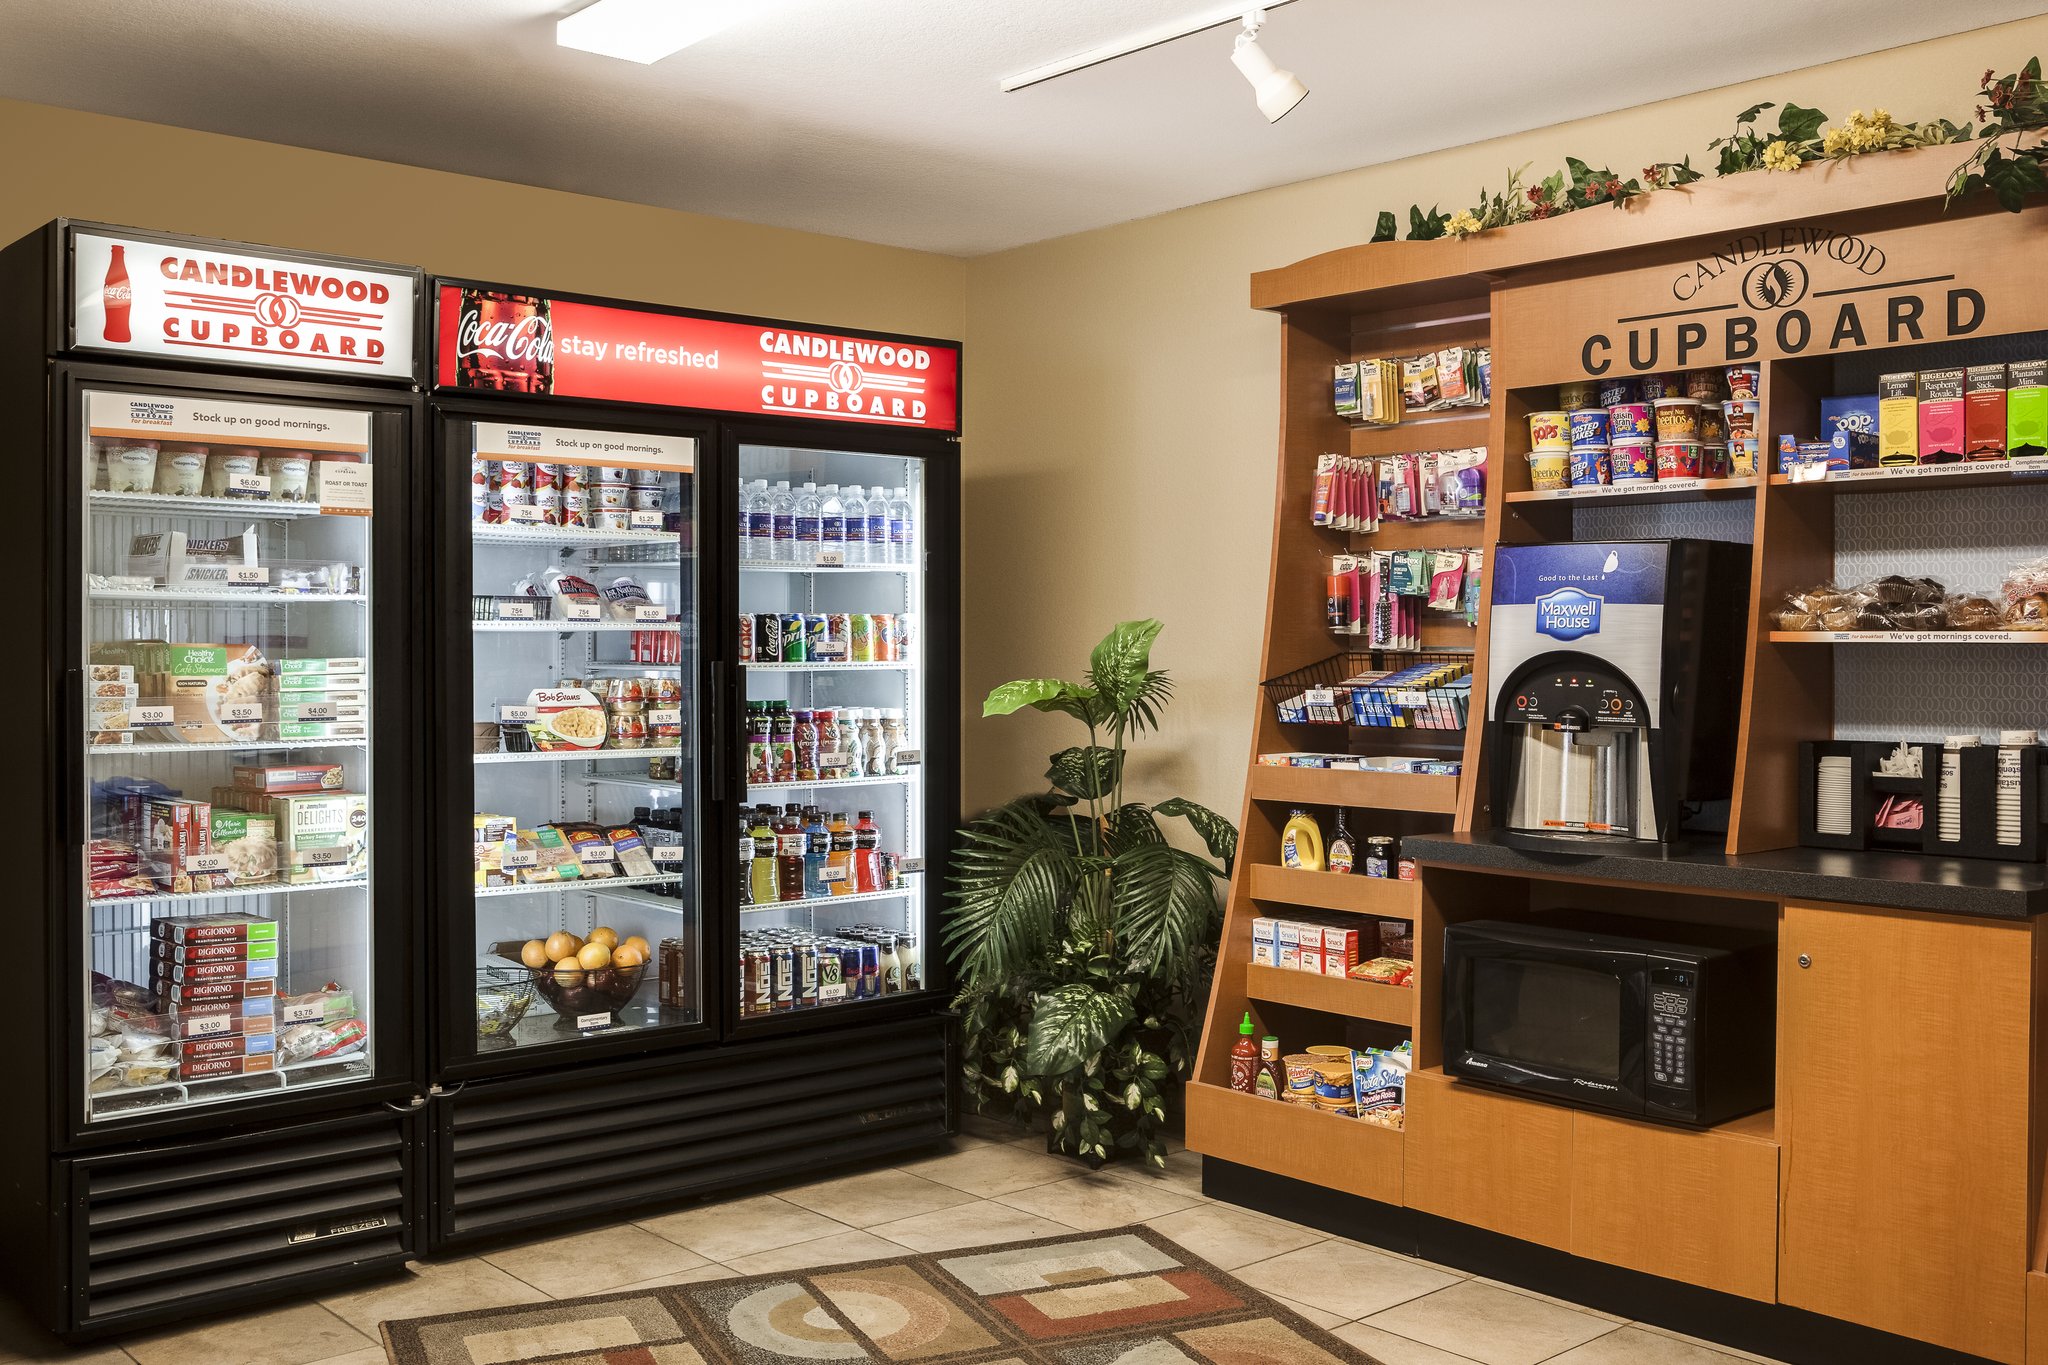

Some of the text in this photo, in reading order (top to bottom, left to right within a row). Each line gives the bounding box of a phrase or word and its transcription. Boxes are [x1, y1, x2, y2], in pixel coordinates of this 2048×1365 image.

[1672, 227, 1887, 301] CANDLEWOOD
[160, 257, 389, 304] CANDLEWOOD
[457, 309, 554, 363] Coca-Cola
[1582, 288, 1986, 376] CUPBOARD
[163, 318, 384, 358] CUPBOARD
[561, 335, 719, 370] stay refreshed
[760, 331, 931, 370] CANDLEWOOD
[1967, 364, 2004, 374] BIGELOW
[2010, 361, 2047, 369] BIGELOW
[1363, 367, 1377, 375] Tums
[1921, 370, 1964, 380] BIGELOW
[2012, 370, 2044, 378] Plantation
[1880, 372, 1916, 381] BIGELOW
[1969, 374, 2002, 382] Cinnamon
[1887, 382, 1908, 390] Lemon
[1925, 381, 1958, 391] Raspberry
[130, 401, 174, 410] CANDLEWOOD
[761, 385, 927, 419] CUPBOARD
[131, 412, 173, 420] CUPBOARD
[1657, 415, 1687, 426] heerios
[193, 412, 330, 432] Stock up on good mornings.
[1571, 421, 1599, 432] ROSTED
[1533, 424, 1559, 446] POPS
[556, 438, 578, 449] Stock
[580, 441, 590, 450] up
[604, 442, 625, 452] good
[626, 444, 664, 454] mornings.
[2015, 459, 2048, 467] Complimenta
[1890, 467, 1915, 476] We've
[1918, 467, 1932, 476] got
[1934, 464, 1973, 475] mornings
[1975, 461, 2012, 471] covered.
[240, 479, 261, 487] $6.00
[1623, 486, 1635, 494] got
[1636, 483, 1667, 492] mornings
[1669, 481, 1698, 490] covered.
[1394, 554, 1420, 567] Blistex
[186, 568, 228, 580] SNICKER
[238, 571, 259, 579] $1.50
[1539, 574, 1556, 582] Good
[1541, 601, 1596, 617] Maxwell
[1546, 616, 1590, 629] House
[1889, 632, 1915, 640] We've
[1917, 633, 1932, 642] got
[1933, 632, 1973, 642] mornings
[1974, 632, 2012, 640] covered.
[184, 655, 215, 664] Choice
[187, 650, 215, 659] Healthy
[193, 664, 226, 674] Steamers
[536, 692, 581, 702] Bob Evans
[142, 711, 164, 719] $3.00
[308, 707, 328, 715] $4.00
[826, 756, 841, 764] $2.00
[298, 809, 343, 826] DELIGHTS
[312, 852, 332, 860] $3.50
[511, 855, 529, 863] $4.00
[197, 859, 218, 867] $2.00
[826, 869, 840, 877] $2.00
[198, 927, 236, 937] DIGIORNO
[1256, 928, 1272, 936] Snack
[1281, 931, 1298, 940] Snack
[1301, 935, 1319, 944] Snack
[1327, 938, 1344, 947] Snack
[198, 946, 236, 956] DIGIORNO
[197, 965, 235, 975] DIGIORNO
[823, 964, 839, 983] V8
[193, 984, 232, 995] DIGIORNO
[191, 1002, 230, 1012] DIGIORNO
[293, 1009, 313, 1017] $3.75
[200, 1021, 221, 1030] $3.00
[195, 1040, 234, 1052] DIGIORNO
[192, 1061, 231, 1072] DIGIORNO
[1465, 1057, 1488, 1069] Amana
[1288, 1067, 1314, 1078] Velveeta
[1356, 1069, 1405, 1088] Pasta Sides
[1380, 1091, 1397, 1100] Rosa
